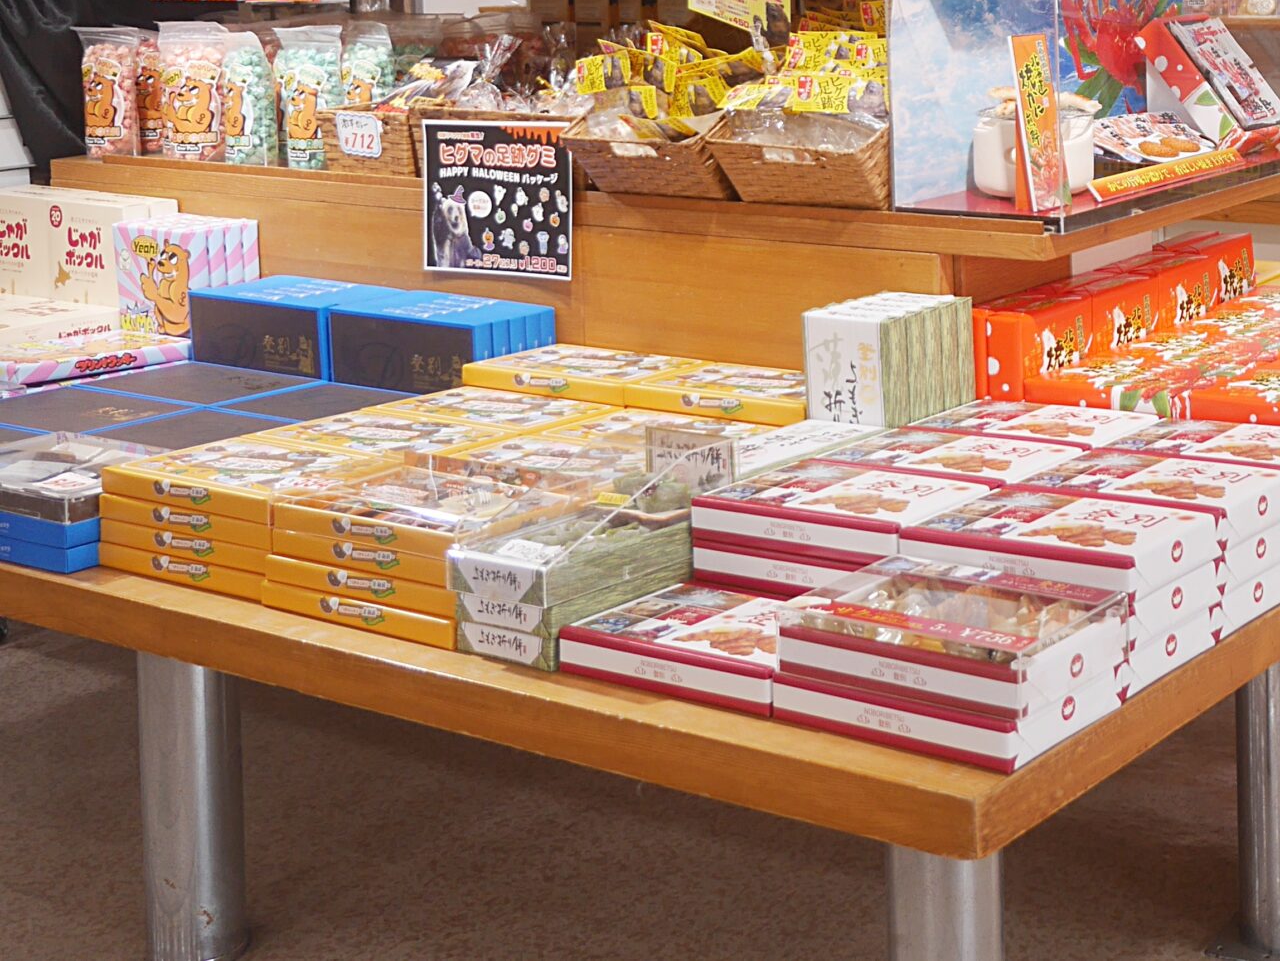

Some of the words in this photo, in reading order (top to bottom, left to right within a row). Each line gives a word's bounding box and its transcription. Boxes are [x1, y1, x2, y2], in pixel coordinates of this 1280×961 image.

[344, 132, 375, 152] ¥712
[439, 143, 557, 168] ヒグマの足跡グミ
[439, 167, 469, 179] HAPPY
[472, 168, 520, 184] HALOWEEN
[521, 173, 559, 185] パッケージ
[67, 226, 102, 250] じゃが
[133, 240, 159, 255] Yeah!
[65, 249, 105, 270] ポックル
[58, 323, 112, 339] じゃがポックル
[959, 626, 1016, 646] ¥756
